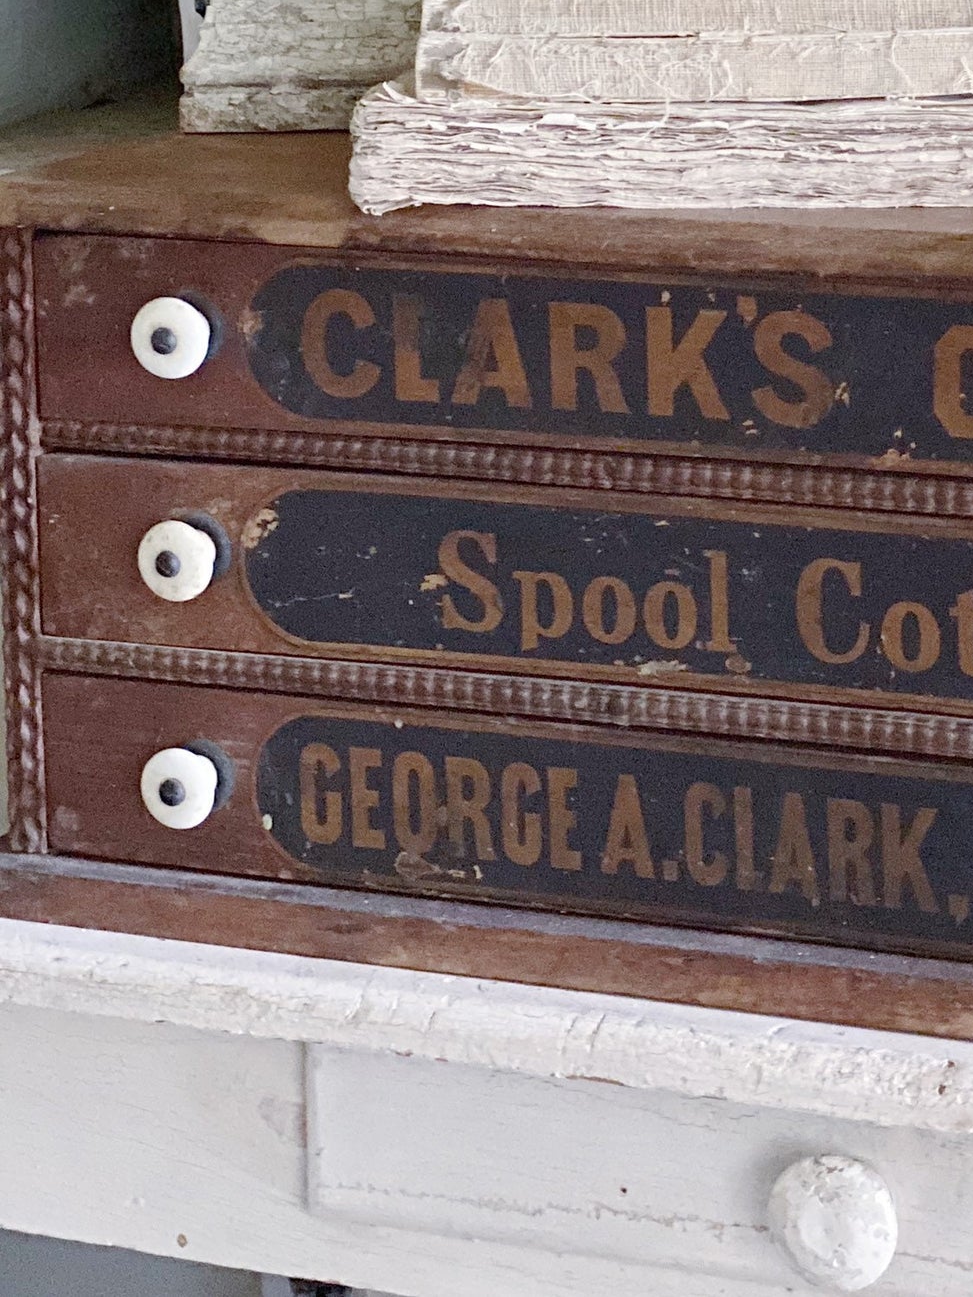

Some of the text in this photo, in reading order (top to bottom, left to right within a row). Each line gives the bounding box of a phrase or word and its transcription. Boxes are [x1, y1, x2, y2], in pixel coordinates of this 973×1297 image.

[301, 288, 835, 429] CLARK'S
[437, 528, 738, 654] Spool
[299, 742, 584, 871] GEORGE
